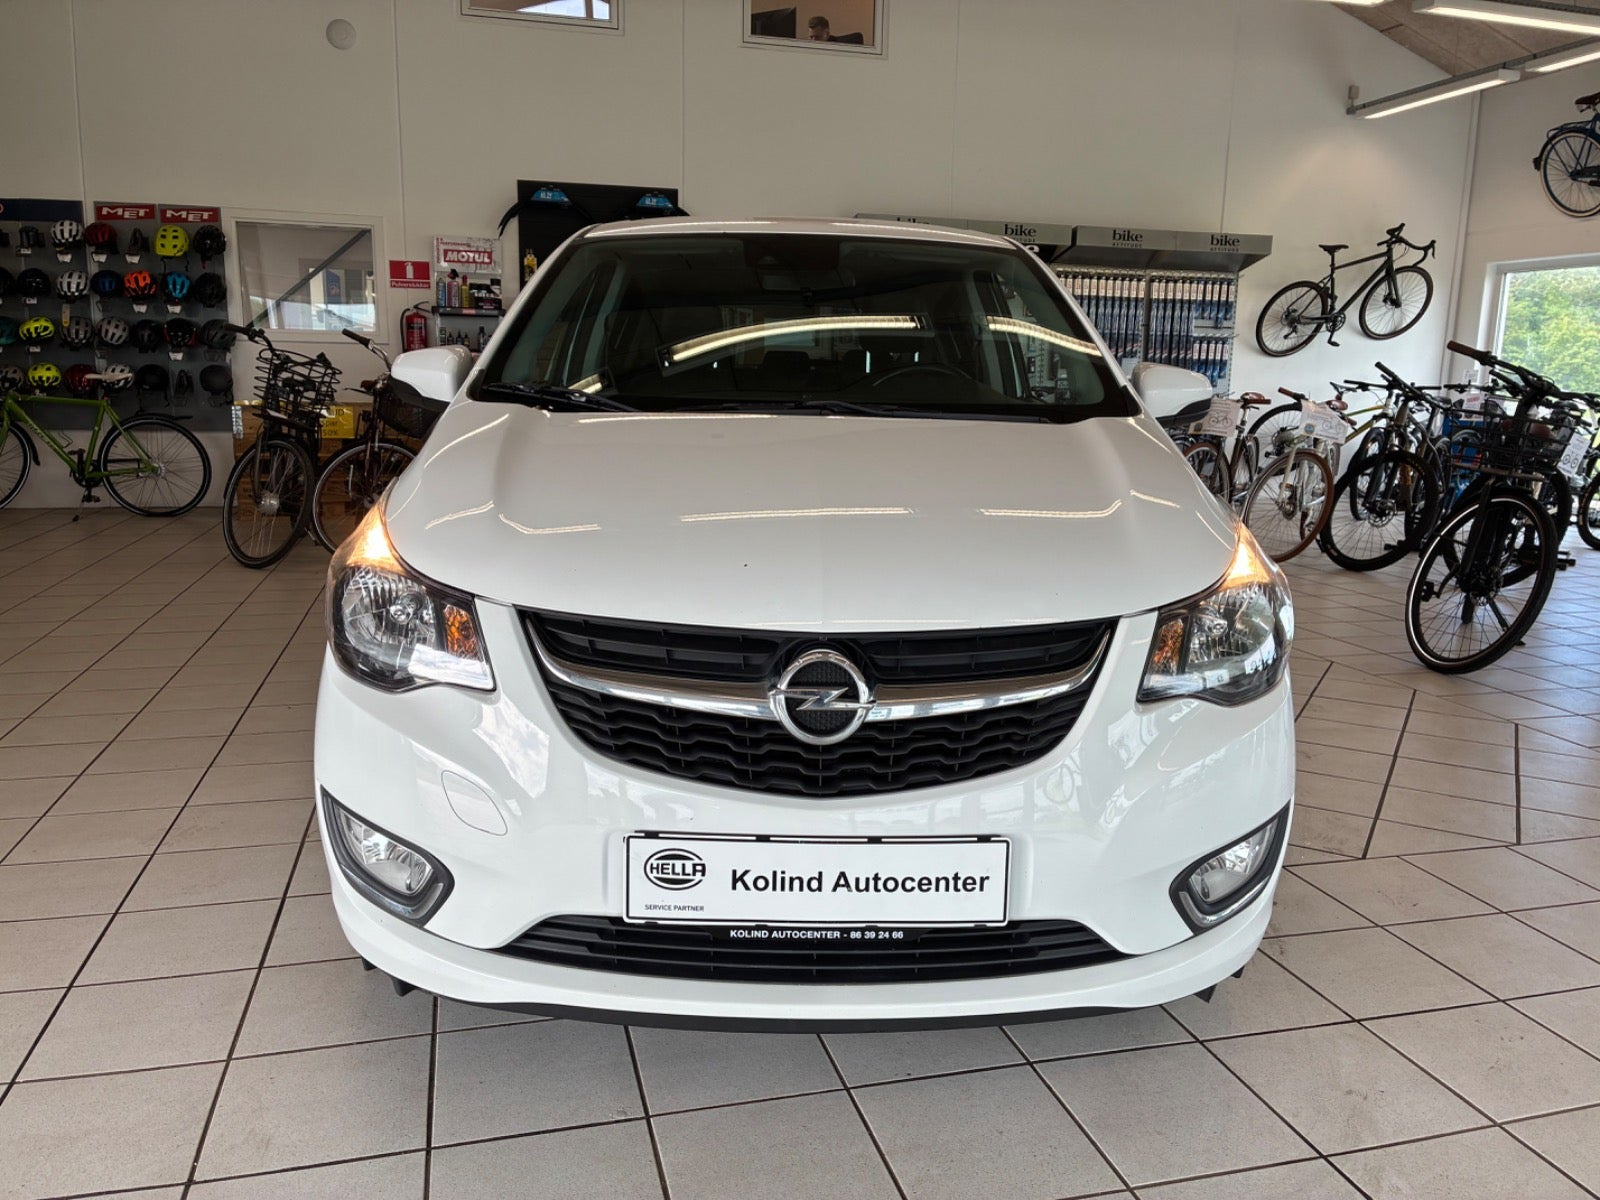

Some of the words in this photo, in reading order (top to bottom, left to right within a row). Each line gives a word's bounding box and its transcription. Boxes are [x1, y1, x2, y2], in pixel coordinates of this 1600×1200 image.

[101, 206, 150, 219] MET
[165, 209, 214, 222] MET
[1004, 223, 1037, 237] bike
[1112, 229, 1144, 242] bike
[1210, 234, 1241, 247] bike
[445, 251, 490, 263] MOTUL
[650, 862, 706, 877] HELLA
[731, 869, 823, 892] Kolind
[831, 871, 990, 893] Autocenter
[644, 904, 672, 912] SERVICE
[730, 930, 769, 939] KOLIND
[771, 931, 841, 939] AUTOCENTER
[850, 931, 861, 939] 86
[864, 931, 876, 939] 39
